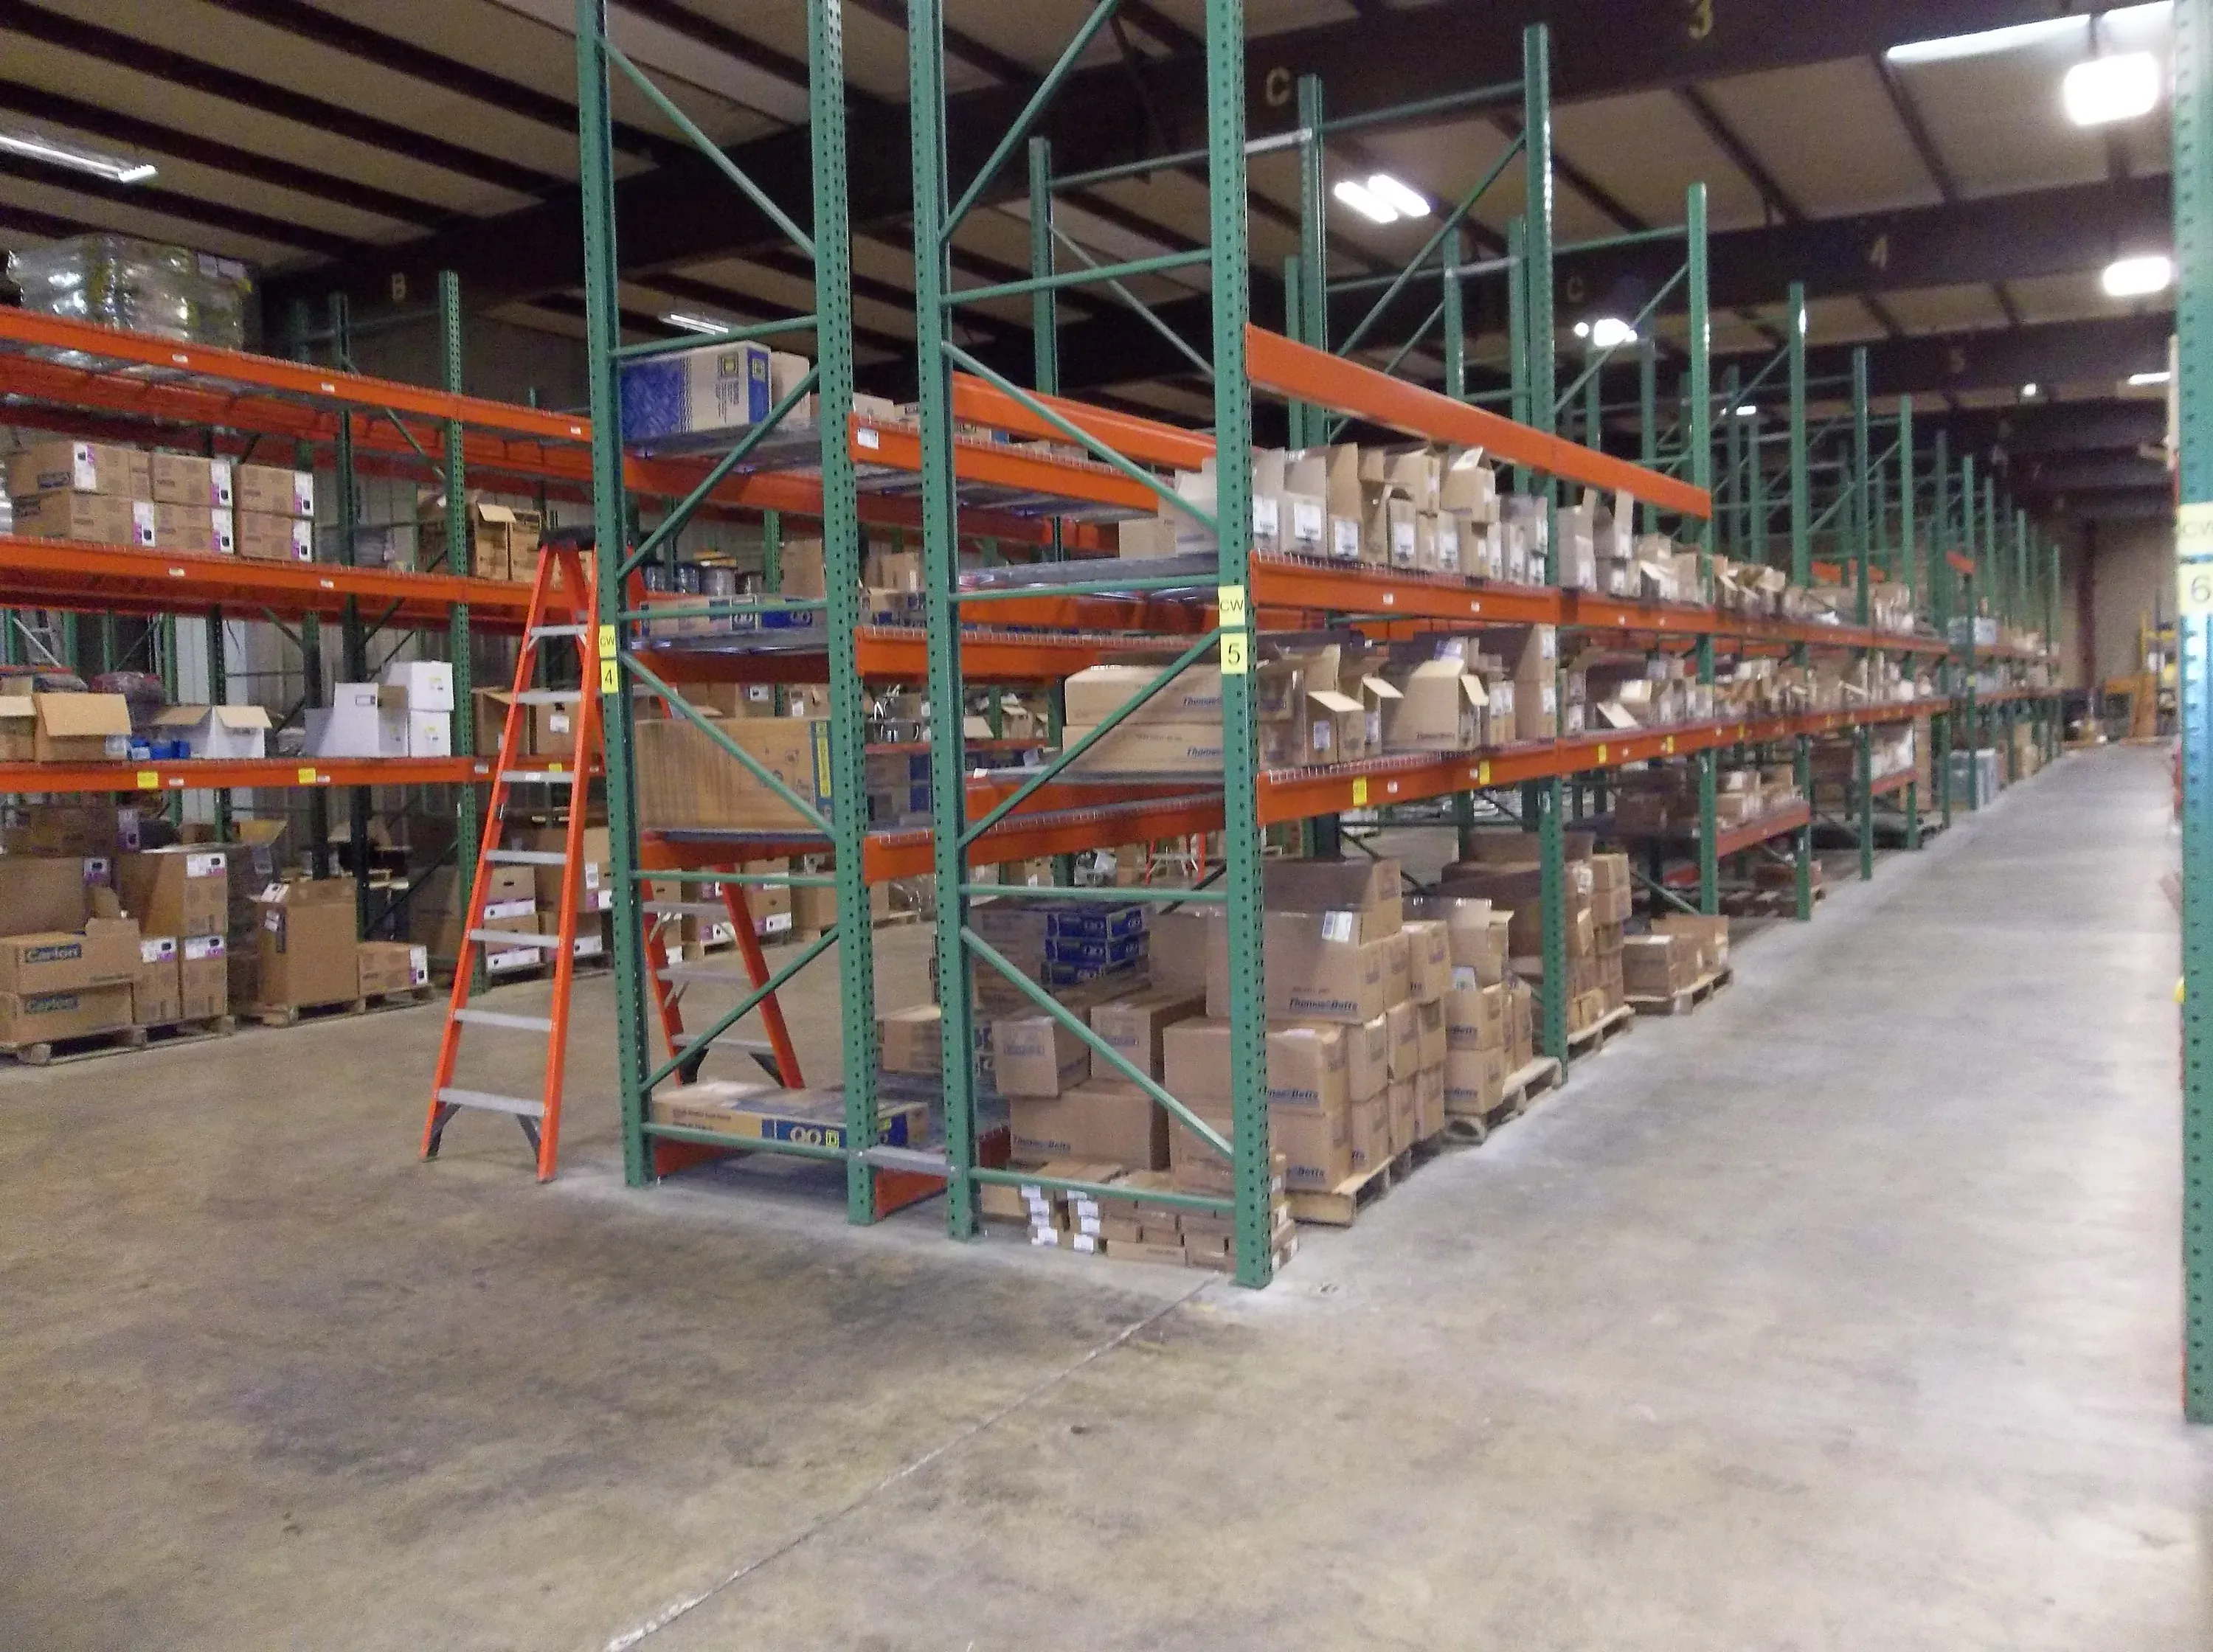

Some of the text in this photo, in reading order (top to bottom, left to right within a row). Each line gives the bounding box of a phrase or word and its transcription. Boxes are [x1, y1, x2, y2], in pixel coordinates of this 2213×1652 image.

[1688, 0, 1712, 39] 3
[1266, 66, 1291, 106] C
[1870, 236, 1888, 268] 4
[2191, 575, 2211, 603] 6
[1220, 599, 1244, 611] CW
[600, 636, 614, 646] CW
[1228, 643, 1240, 665] 5
[605, 668, 614, 686] 4
